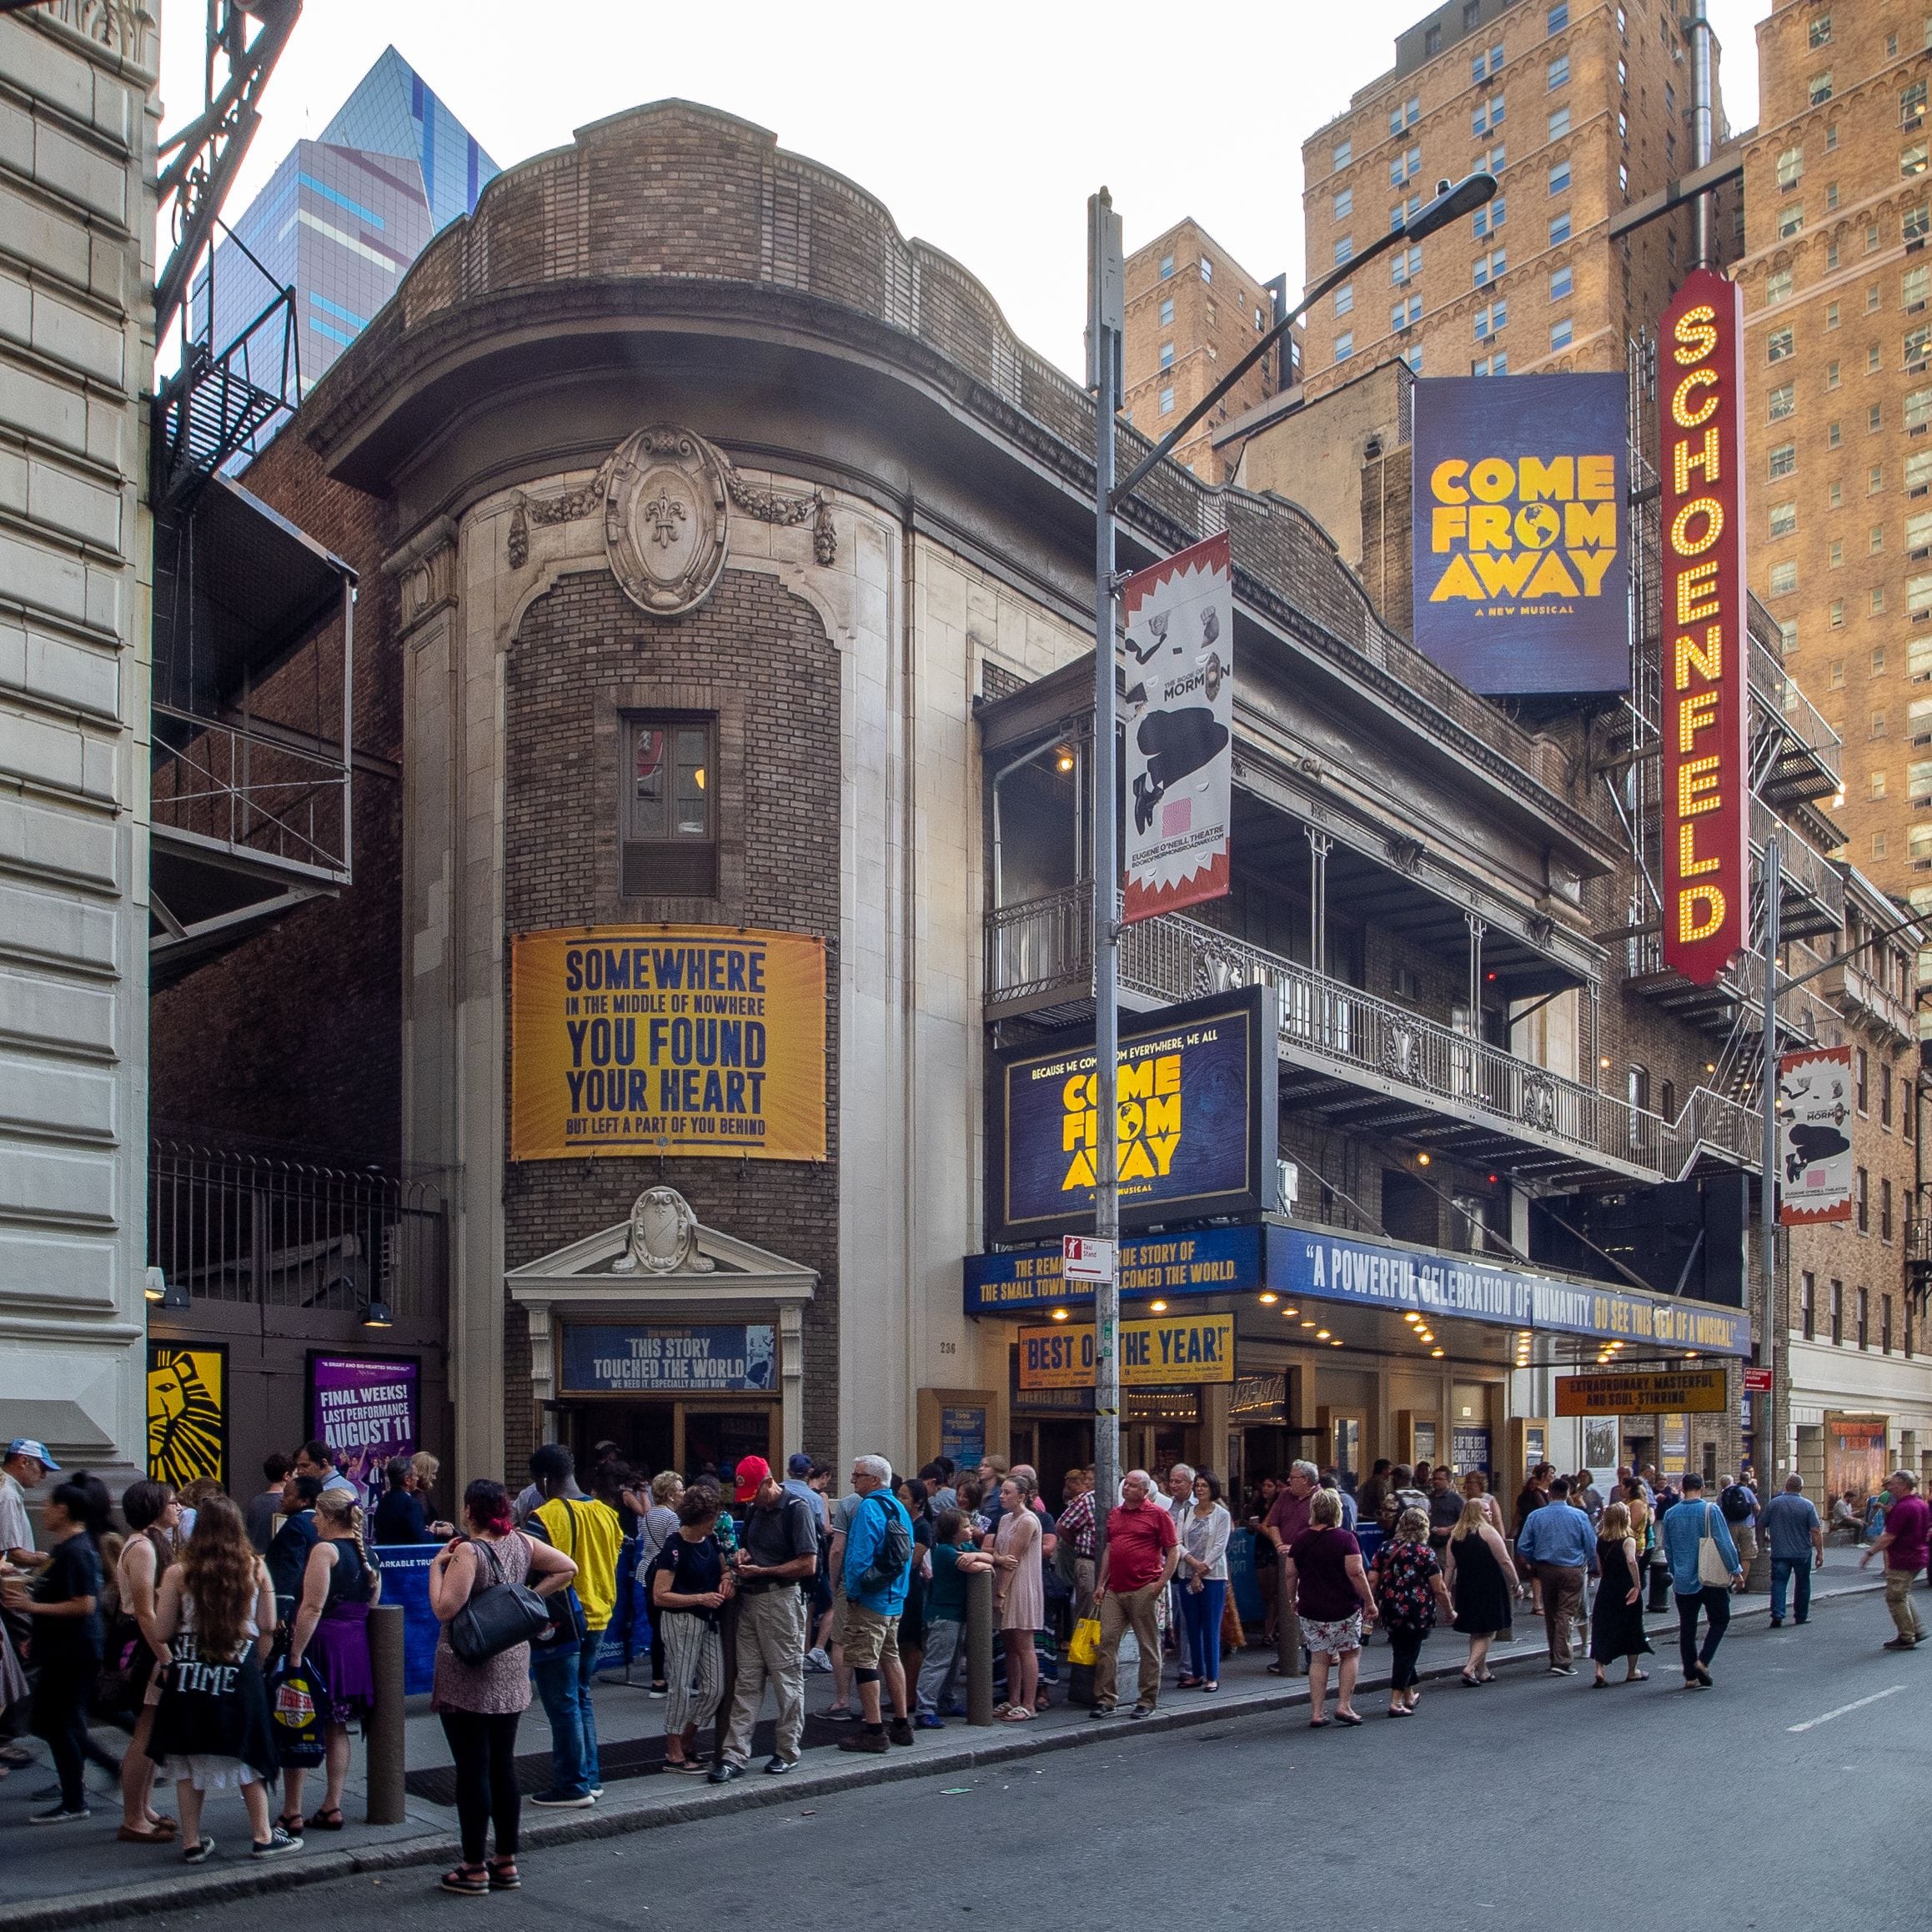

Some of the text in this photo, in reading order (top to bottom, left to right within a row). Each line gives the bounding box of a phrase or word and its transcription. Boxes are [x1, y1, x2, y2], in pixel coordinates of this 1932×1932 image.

[1430, 455, 1615, 504] COME
[1432, 502, 1617, 553] FROM
[1428, 549, 1618, 601] AWAY
[1474, 605, 1574, 617] A NEW MUSICAL
[1671, 305, 1726, 943] SCHOENFELD
[1132, 825, 1224, 861] EUGENE O'NEILL THEATRE
[565, 948, 766, 993] SOMEWHERE
[565, 995, 765, 1016] IN THE MIDDLE OF NOWHERE
[566, 1017, 765, 1068] YOU FOUND
[1032, 1061, 1064, 1080] BECAUSE
[1066, 1061, 1077, 1072] WE
[1080, 1057, 1097, 1069] COM
[1129, 1037, 1184, 1059] EVERYWHERE,
[1187, 1034, 1199, 1046] WE
[1201, 1029, 1217, 1043] ALL
[566, 1069, 765, 1114] YOUR HEART
[566, 1117, 765, 1136] BUT LEFT A PART OF YOU BEHIND
[1117, 1184, 1152, 1196] MUSICAL
[1015, 1259, 1035, 1277] THE
[1140, 1244, 1177, 1263] STORY
[1180, 1241, 1196, 1261] OF
[981, 1284, 999, 1302] THE
[1001, 1281, 1034, 1301] SMALL
[1037, 1278, 1067, 1297] TOWN
[1166, 1267, 1187, 1286] THE
[1190, 1261, 1237, 1283] WORLD.
[1332, 1248, 1418, 1302] POWERFUL
[1420, 1264, 1512, 1316] CELEBRATION
[1515, 1282, 1531, 1317] OF
[1533, 1286, 1592, 1327] HUMANITY.
[1594, 1296, 1608, 1329] GO
[1611, 1299, 1629, 1332] SEE
[1631, 1304, 1653, 1336] THIS
[1654, 1307, 1674, 1339] GEM
[1677, 1311, 1688, 1341] OF
[1689, 1314, 1694, 1342] A
[665, 1337, 710, 1357] STORY
[941, 1342, 956, 1354] 236
[1081, 1334, 1094, 1367] O
[594, 1359, 747, 1378] TOUCHED THE WORLD.
[610, 1379, 622, 1388] WE
[625, 1379, 640, 1388] NEED
[651, 1379, 689, 1388] ESPECIALLY
[690, 1379, 709, 1388] RIGHT
[1654, 1374, 1714, 1389] MASTERFUL
[320, 1384, 407, 1408] FINAL WEEKS!
[1587, 1393, 1606, 1406] AND
[323, 1403, 409, 1424] LAST PERFORMANCE
[325, 1416, 410, 1449] AUGUST 11
[379, 1559, 414, 1568] ARKABLE
[177, 1662, 240, 1696] TIME
